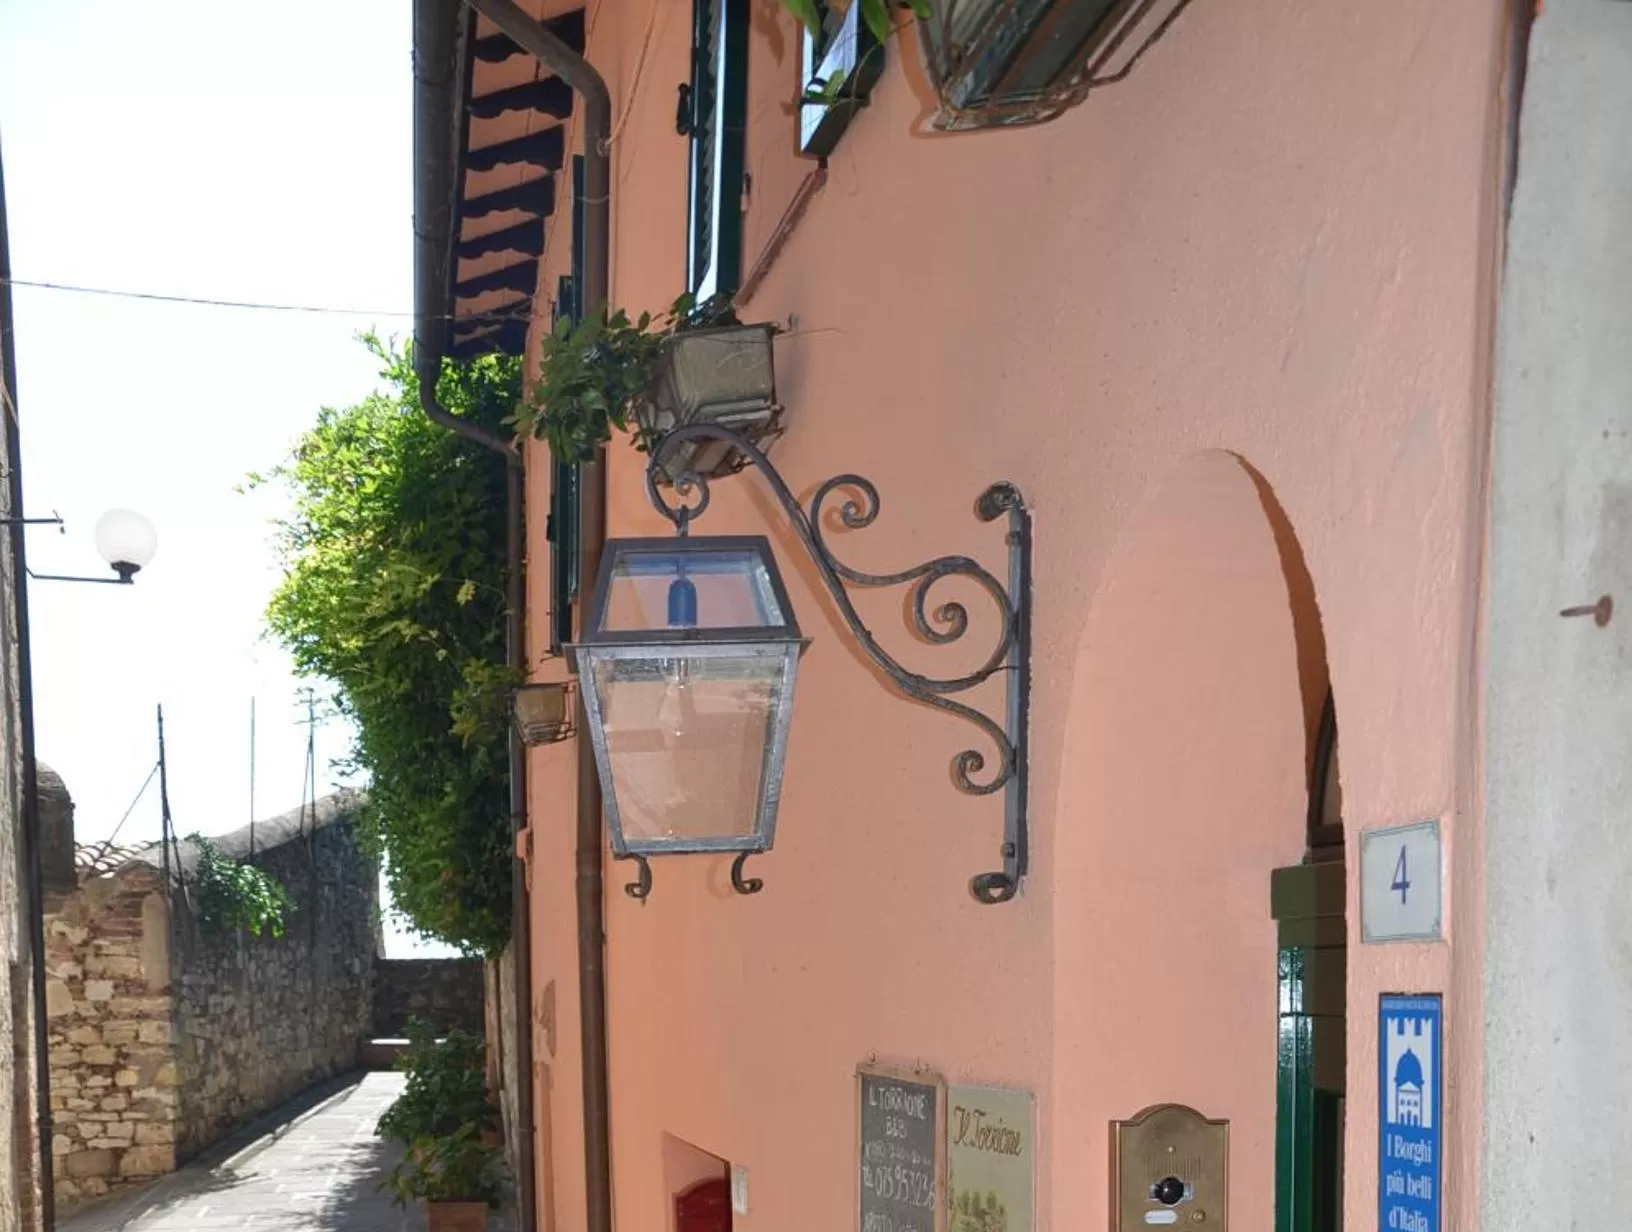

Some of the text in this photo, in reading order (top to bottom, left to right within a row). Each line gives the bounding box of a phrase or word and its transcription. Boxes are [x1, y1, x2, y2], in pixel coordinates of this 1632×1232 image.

[1391, 844, 1411, 905] 4
[970, 1108, 1022, 1157] Torrione
[1387, 1133, 1432, 1166] I Borghi
[1386, 1168, 1432, 1200] più belli
